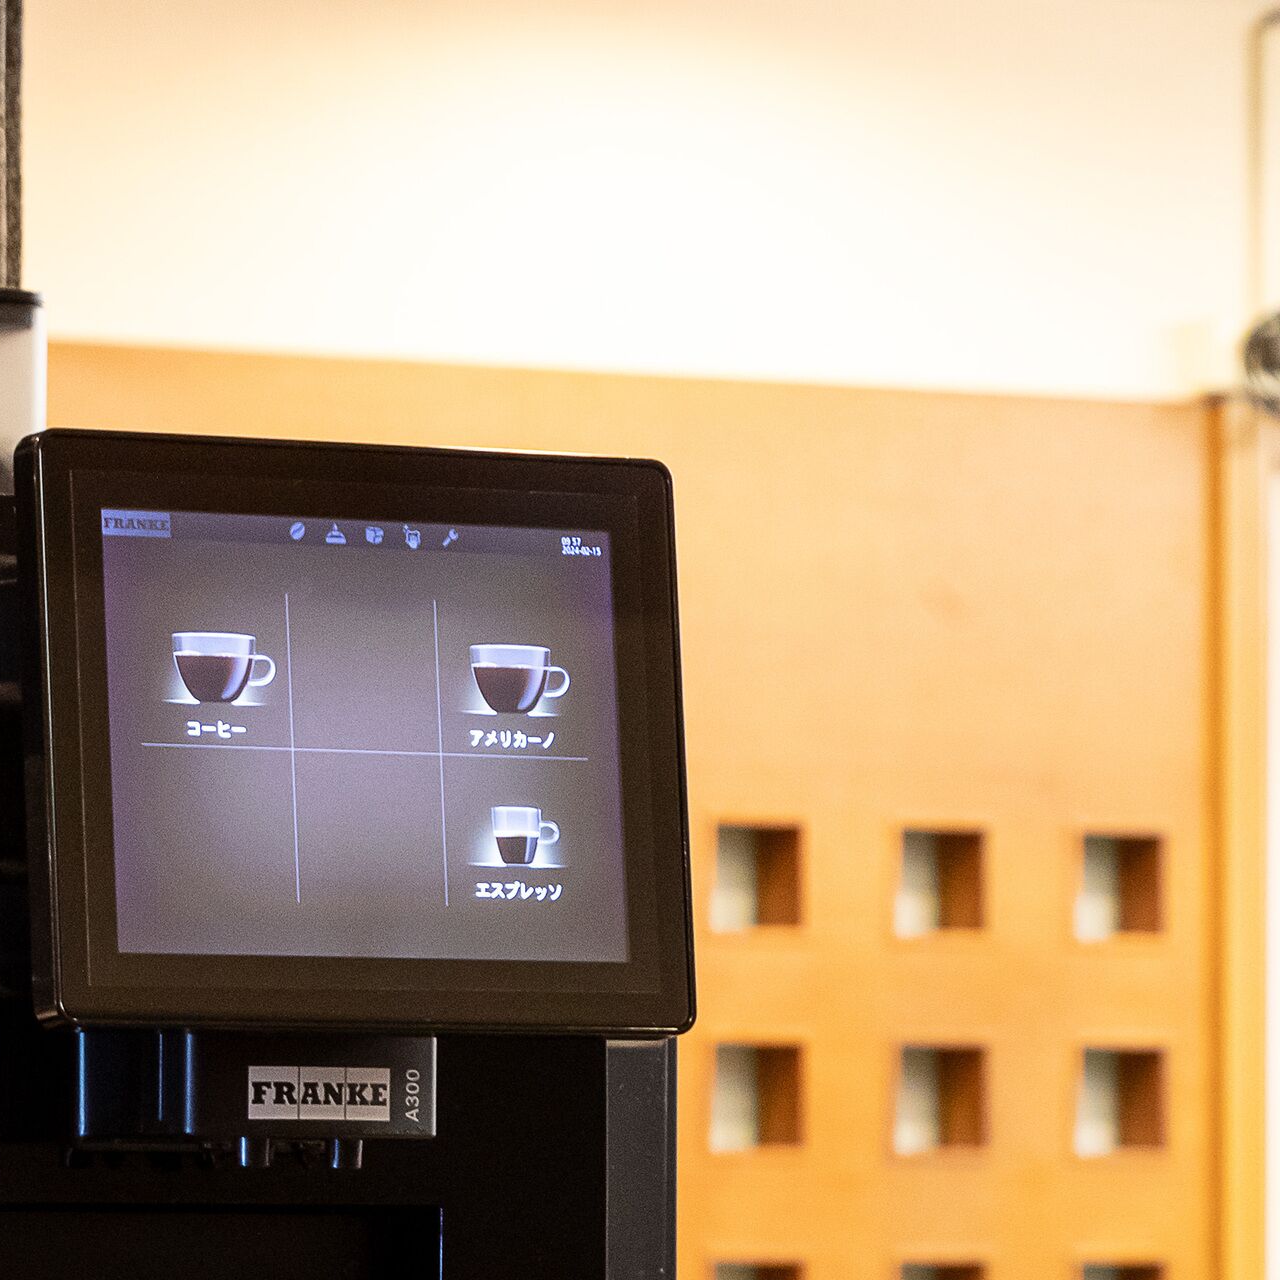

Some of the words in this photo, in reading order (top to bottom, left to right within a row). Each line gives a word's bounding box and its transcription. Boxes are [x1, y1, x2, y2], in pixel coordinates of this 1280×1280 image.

[104, 517, 168, 531] FRANKE
[186, 720, 247, 739] コーヒー
[469, 729, 555, 749] アメリカーノ
[475, 880, 563, 901] エスプレッソ
[251, 1081, 388, 1106] FRANKE
[405, 1069, 420, 1123] A300
